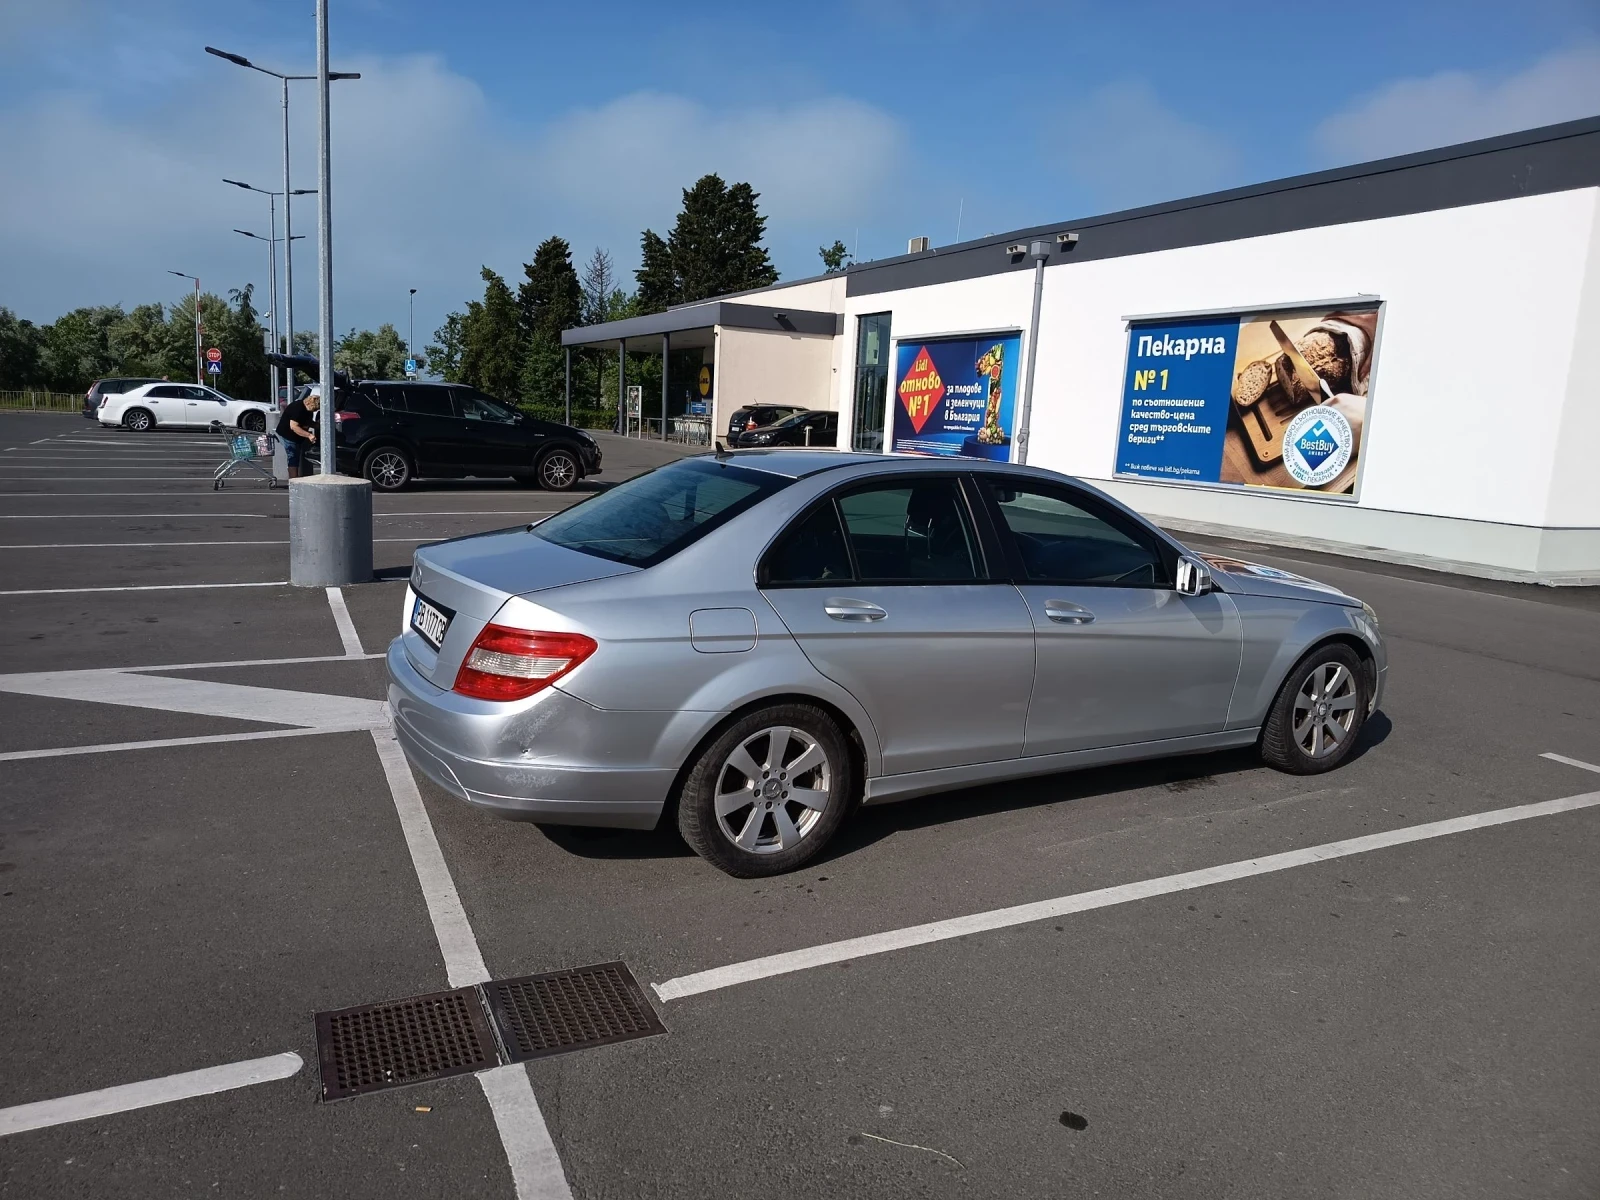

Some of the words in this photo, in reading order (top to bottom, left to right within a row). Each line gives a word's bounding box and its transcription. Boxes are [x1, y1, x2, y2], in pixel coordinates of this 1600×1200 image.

[1138, 334, 1226, 360] Пекарна
[915, 359, 928, 372] Lidl
[900, 371, 941, 394] отново
[946, 386, 954, 396] за
[954, 382, 982, 396] плодове
[946, 399, 950, 407] и
[951, 398, 985, 410] зеленчуци
[1144, 399, 1205, 407] съотношение
[949, 410, 980, 424] България
[1131, 409, 1195, 421] качество-цена
[1129, 423, 1149, 433] сред
[1150, 423, 1211, 434] търговските
[1300, 439, 1334, 453] BestBuy
